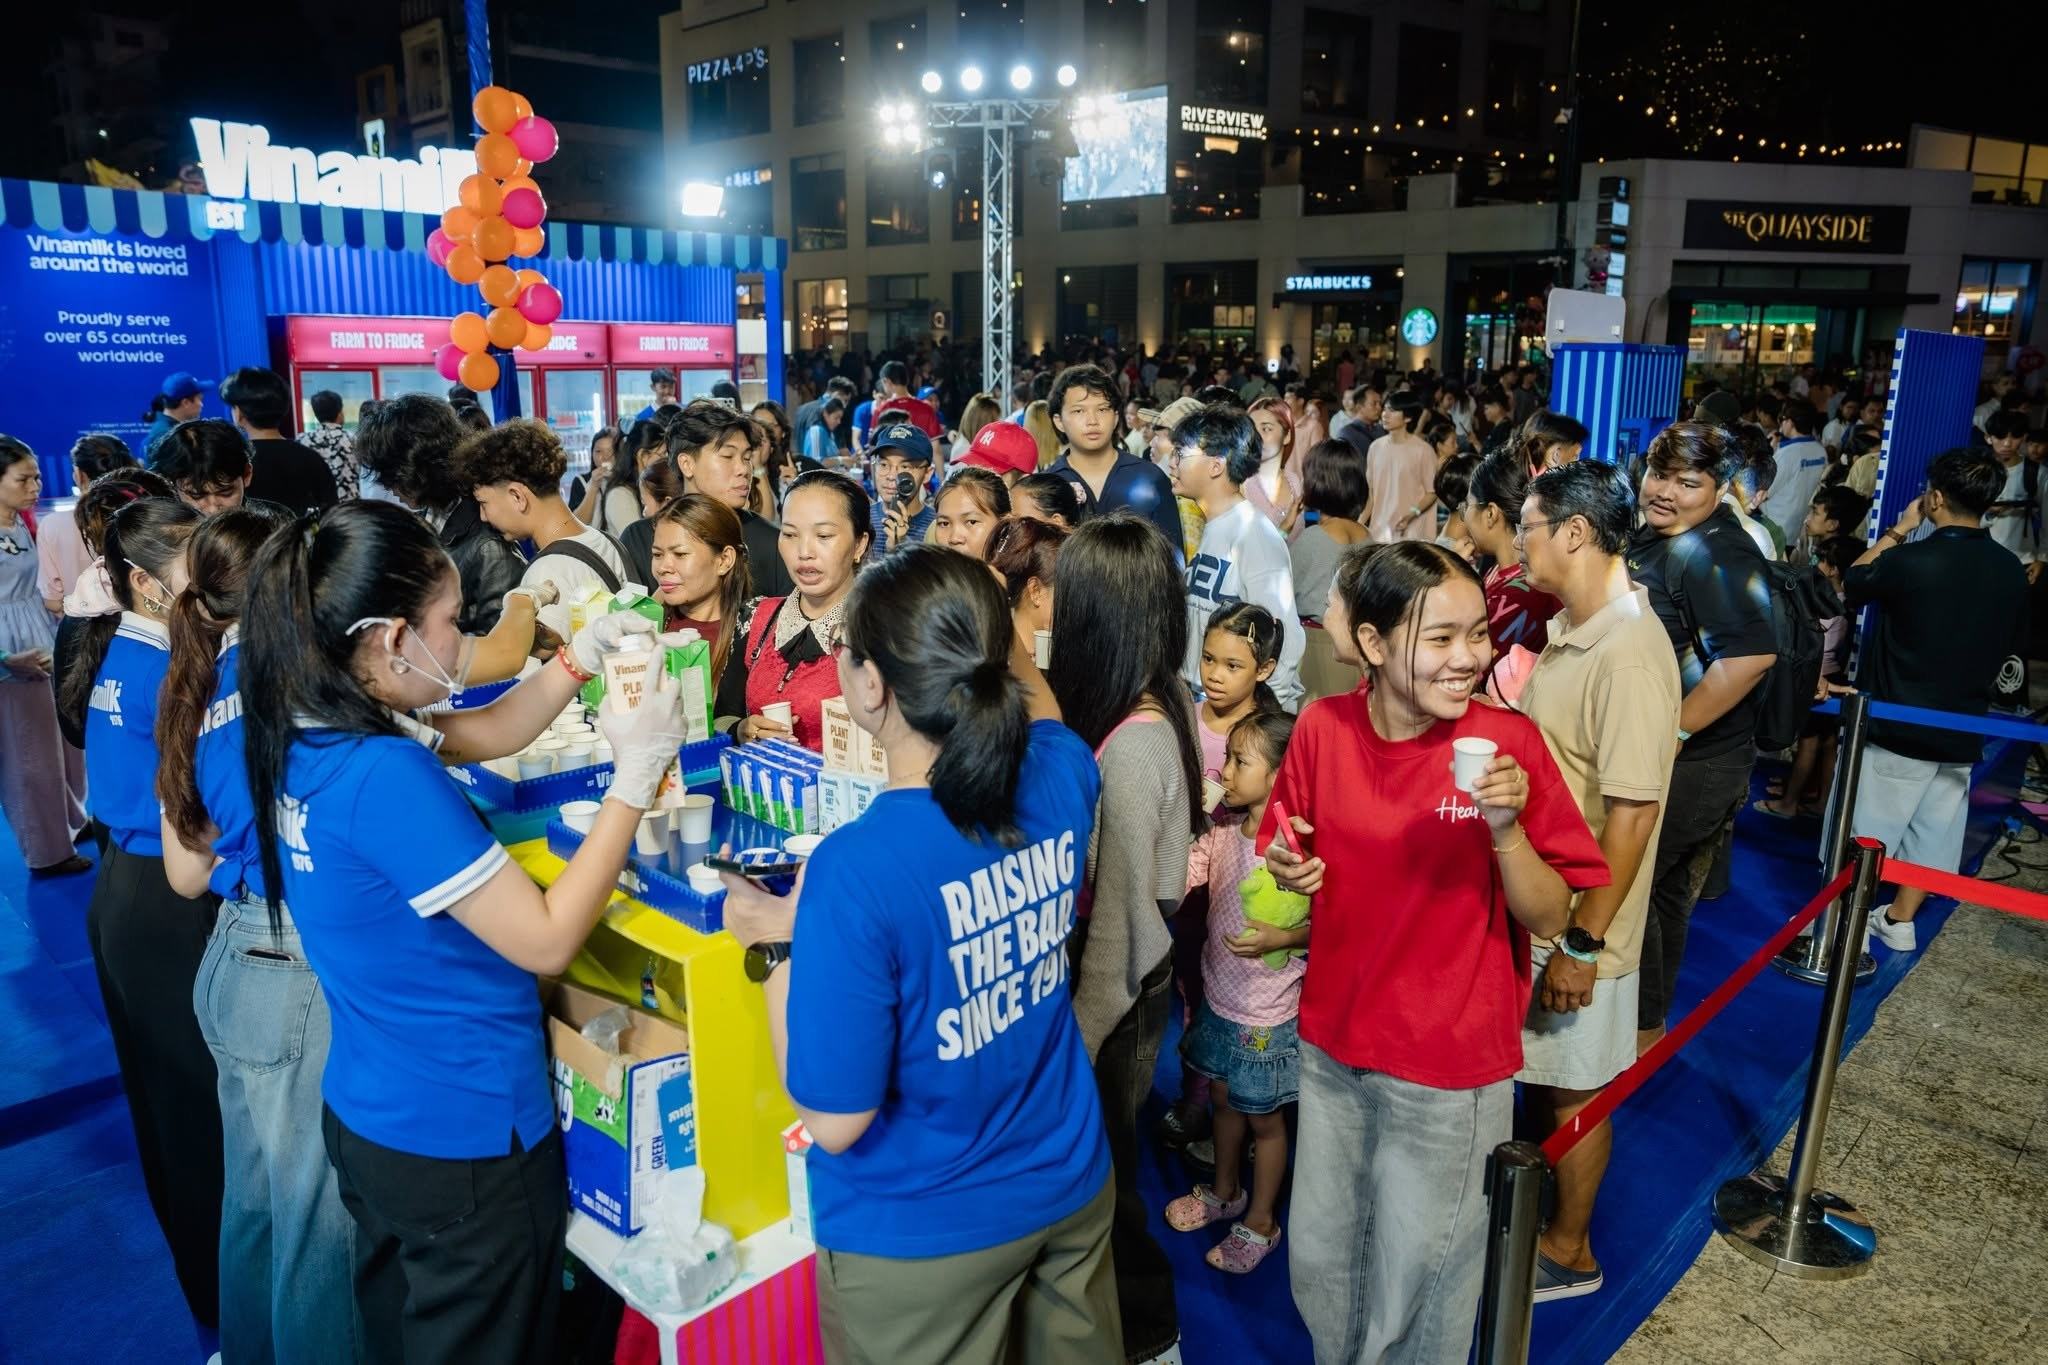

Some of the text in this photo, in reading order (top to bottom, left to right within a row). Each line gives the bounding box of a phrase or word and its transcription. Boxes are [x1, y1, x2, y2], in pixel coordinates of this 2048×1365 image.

[688, 58, 732, 84] PIZZA
[1181, 105, 1264, 129] RIVERVIEW
[206, 202, 247, 230] EST
[1746, 212, 1873, 242] QUAYSIDE
[26, 234, 187, 260] Vinamilk is loved
[30, 255, 189, 276] around the world
[1286, 276, 1372, 290] STARBUCKS
[58, 311, 170, 327] Proudly serve
[44, 331, 187, 345] over 65 countries
[330, 332, 425, 349] FARM TO FRIDGE
[549, 336, 578, 350] RIDGE
[639, 336, 709, 350] FARM TO FRIDGE
[78, 350, 164, 363] worldwide
[614, 663, 647, 676] Vinam
[623, 682, 643, 696] PLA
[1435, 796, 1486, 823] Hear
[939, 830, 1074, 941] RAISING
[948, 888, 1074, 1000] THE BAR
[936, 970, 1025, 1062] SINCE
